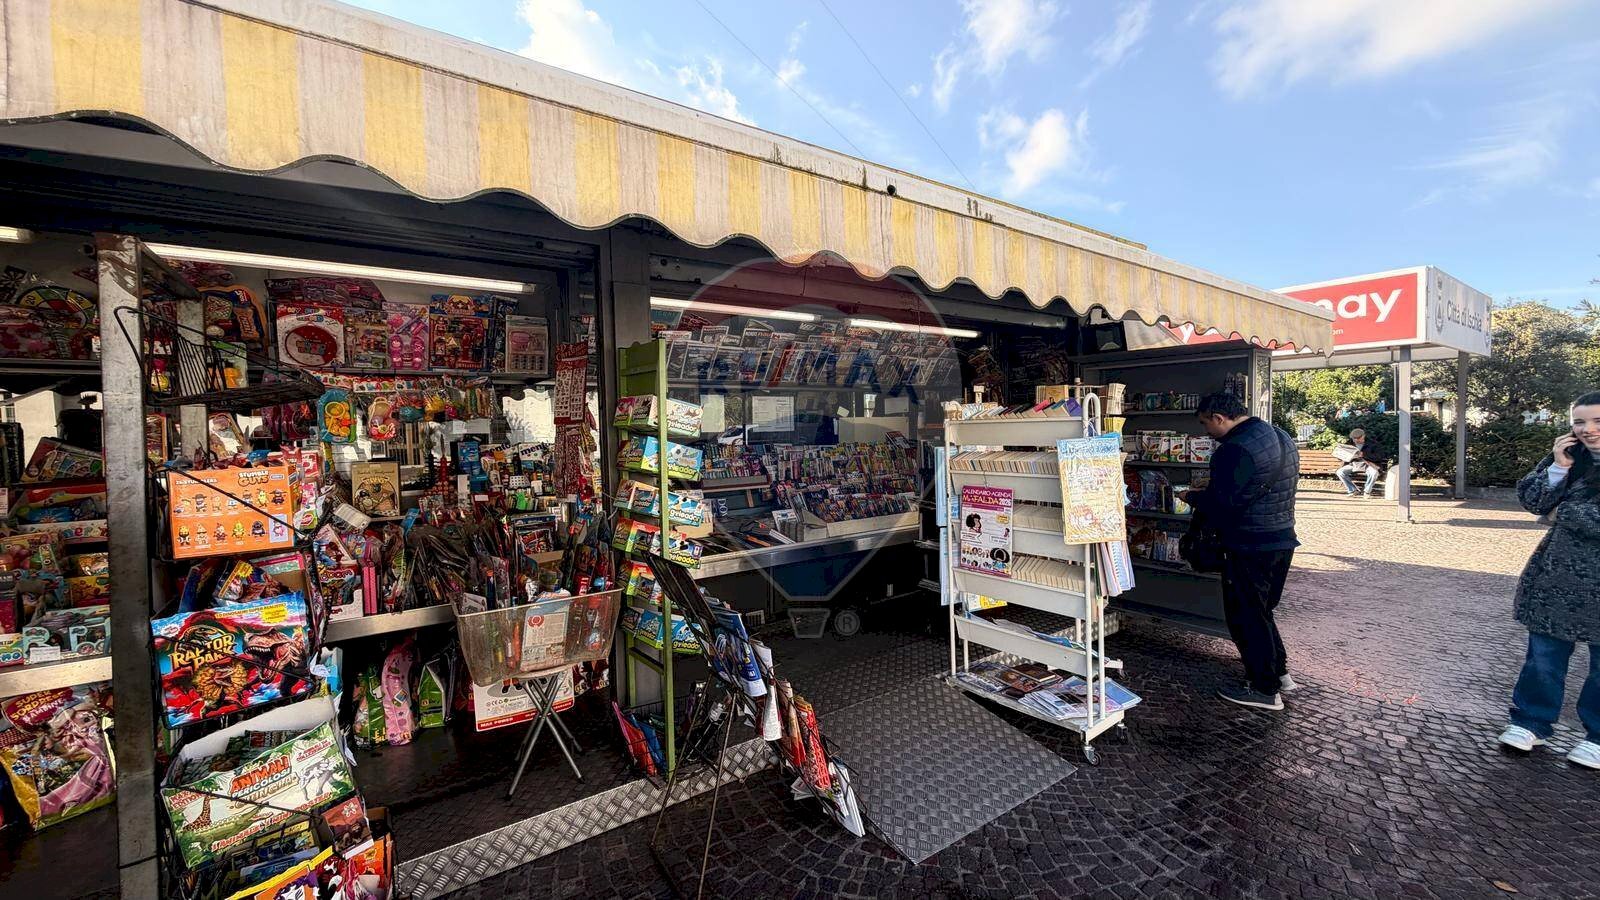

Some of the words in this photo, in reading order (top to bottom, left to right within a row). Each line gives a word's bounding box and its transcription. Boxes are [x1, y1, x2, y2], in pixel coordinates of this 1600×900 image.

[1467, 307, 1482, 333] Ischia
[238, 475, 269, 487] GUYS
[231, 755, 290, 793] ANIMALI
[232, 768, 290, 798] PERICOLOSI
